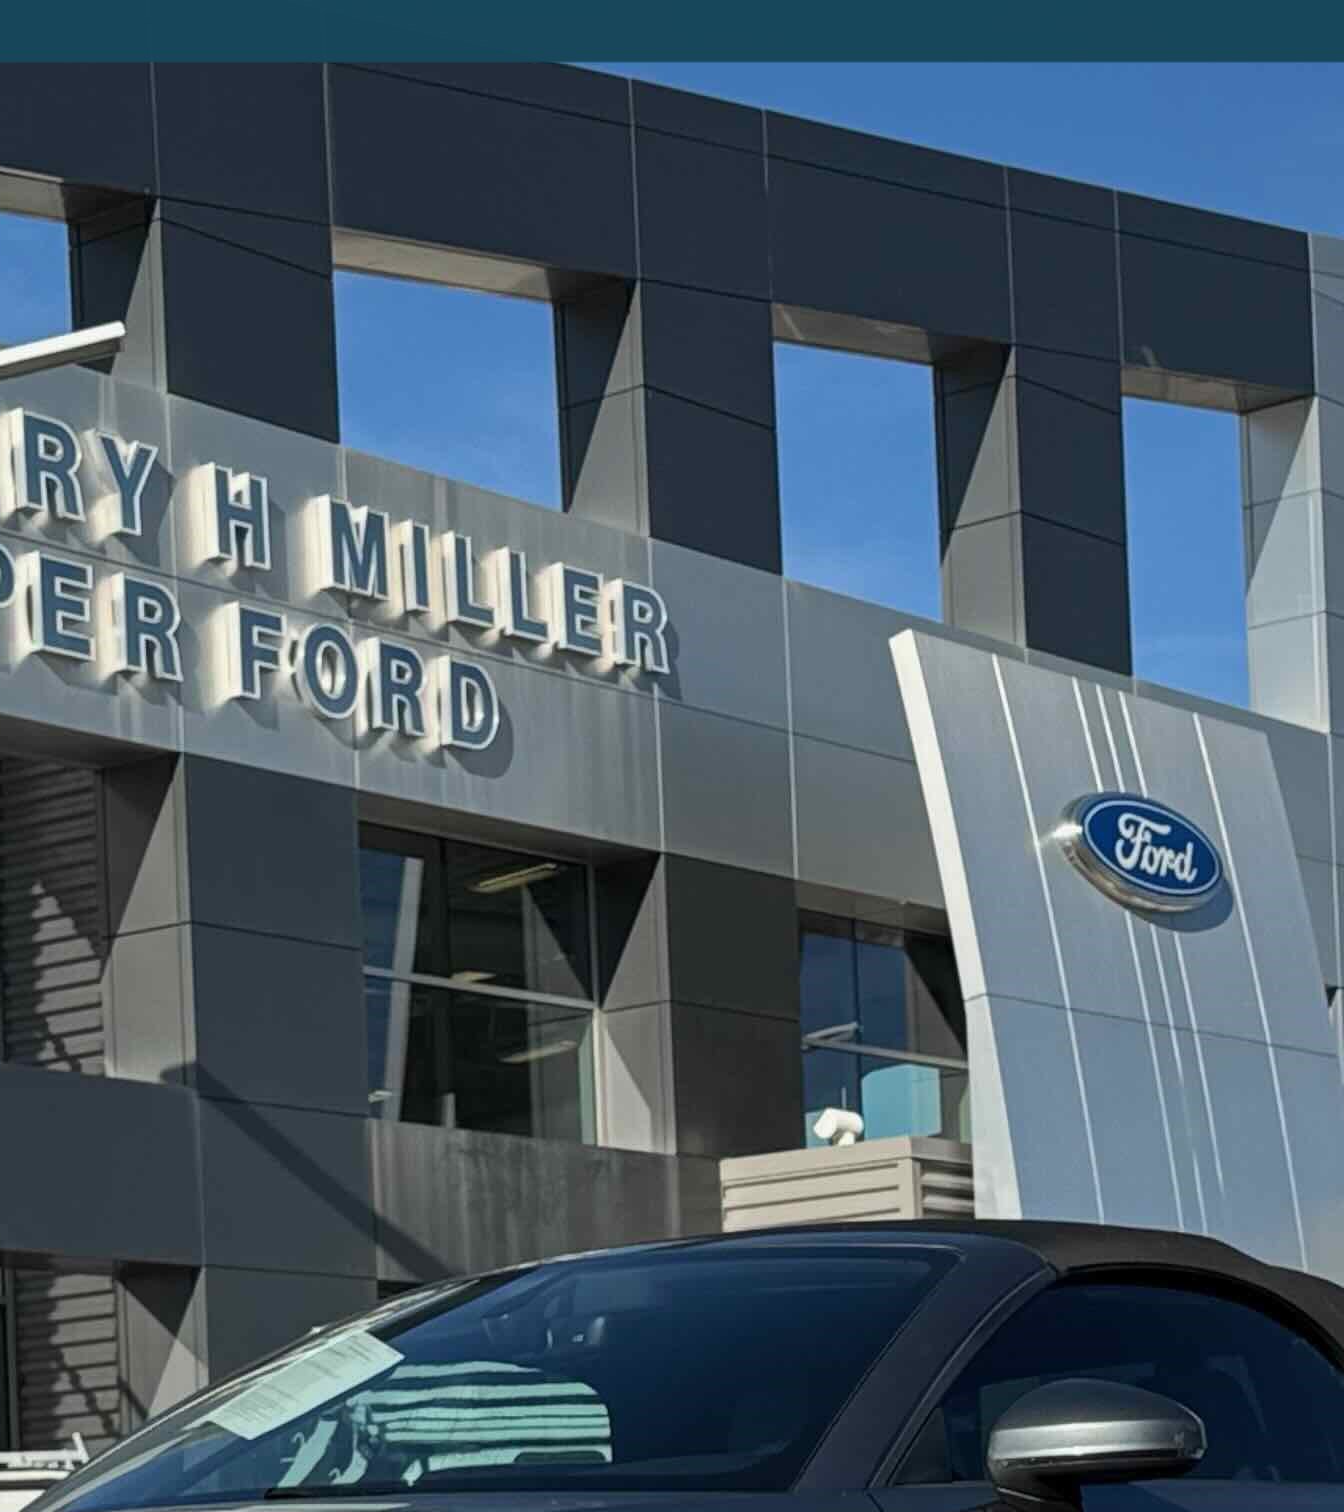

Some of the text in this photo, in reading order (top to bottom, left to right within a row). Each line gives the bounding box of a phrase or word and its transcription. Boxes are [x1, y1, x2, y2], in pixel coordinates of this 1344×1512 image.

[204, 461, 272, 571] H
[318, 494, 670, 675] MILLER
[224, 601, 501, 751] FORD
[1115, 812, 1198, 883] Ford
